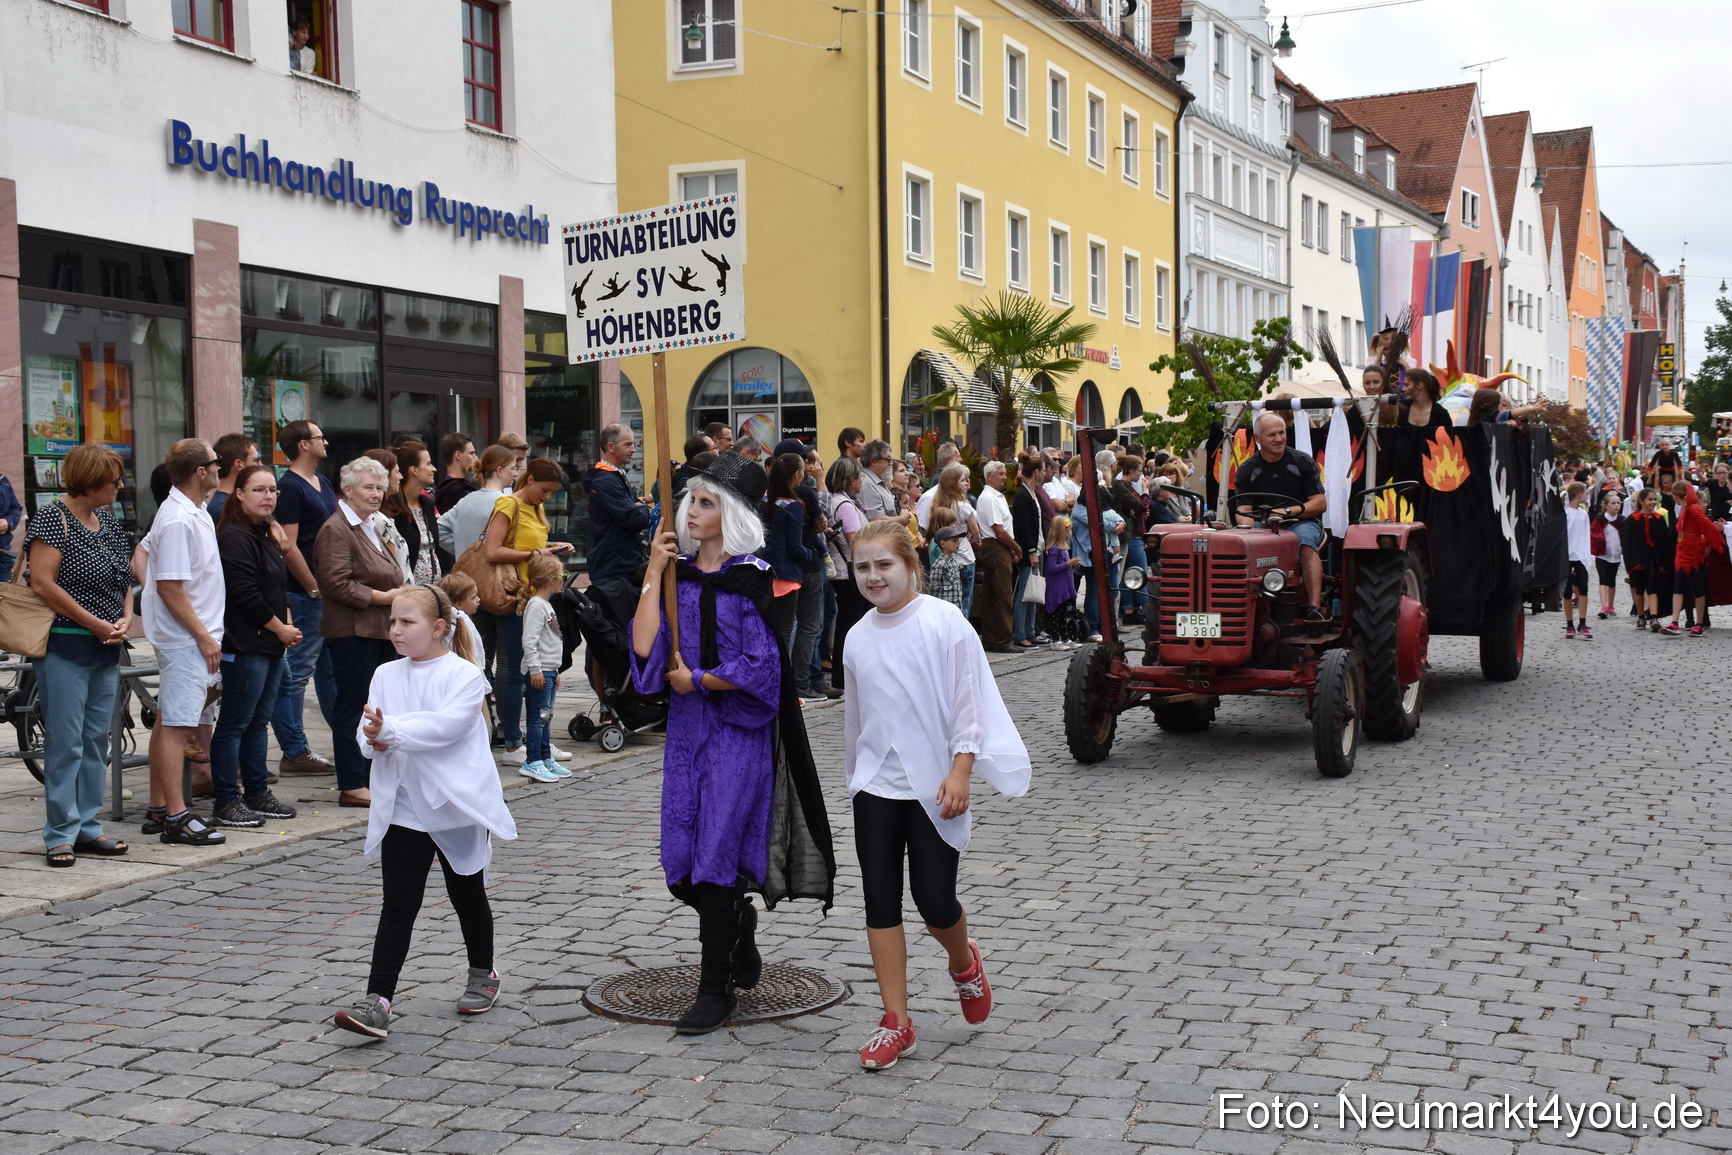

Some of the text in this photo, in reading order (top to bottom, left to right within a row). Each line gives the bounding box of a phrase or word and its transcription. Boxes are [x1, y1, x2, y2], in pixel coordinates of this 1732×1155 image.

[167, 118, 549, 245] Buchhandlung Rupprecht
[564, 206, 736, 266] TURNABTEILUNG
[636, 266, 666, 298] SV
[586, 299, 721, 349] HÖHENBERG
[741, 366, 764, 383] FOTO
[1660, 344, 1675, 400] HOTE
[1181, 627, 1217, 637] J 380
[1190, 615, 1209, 625] BEI
